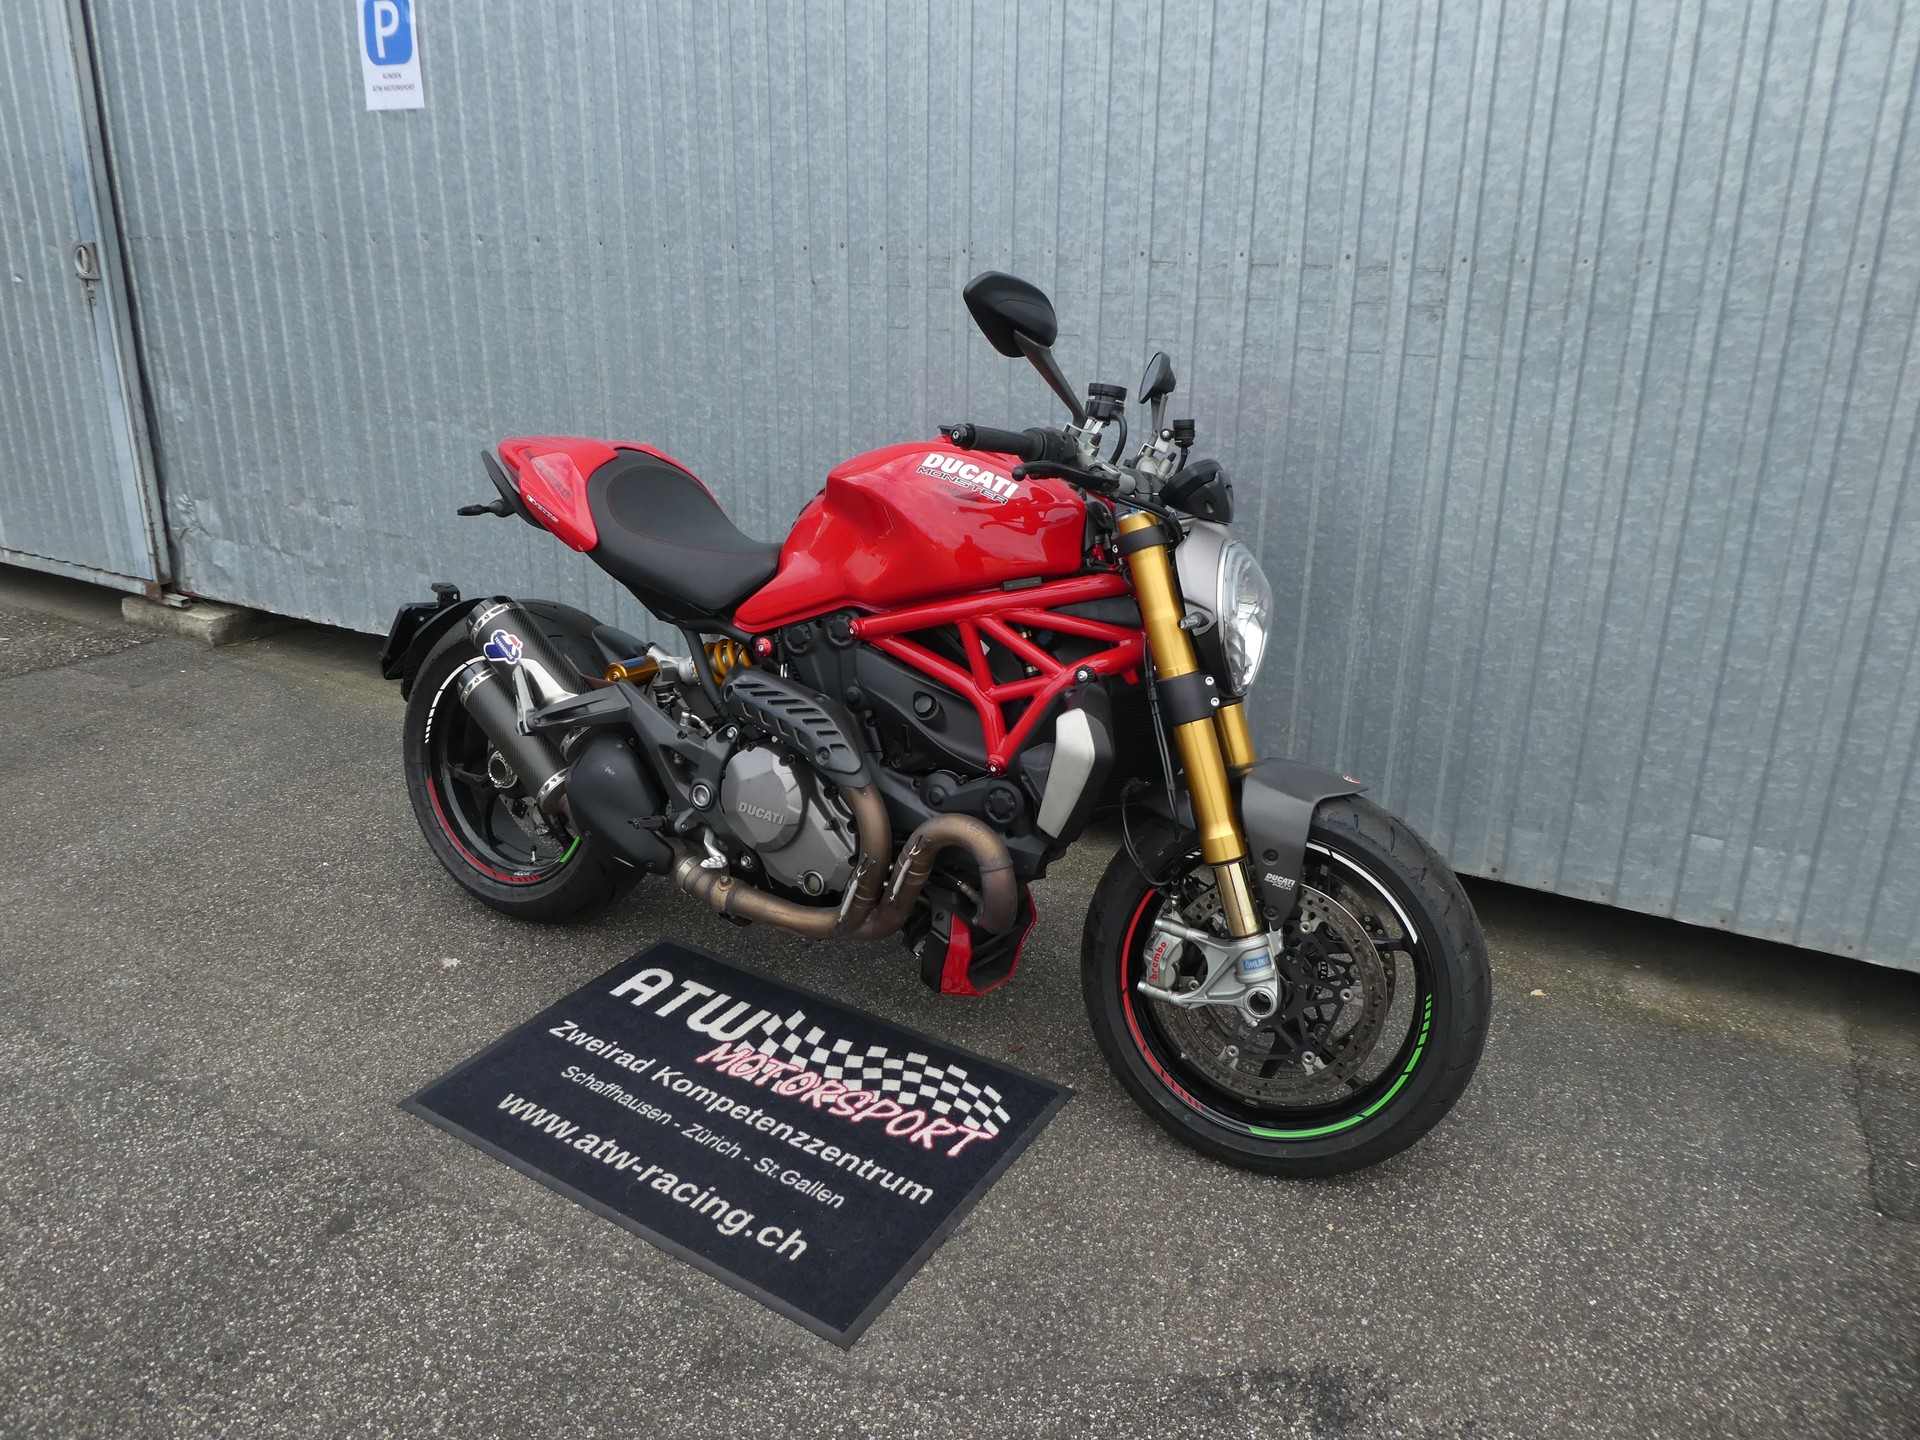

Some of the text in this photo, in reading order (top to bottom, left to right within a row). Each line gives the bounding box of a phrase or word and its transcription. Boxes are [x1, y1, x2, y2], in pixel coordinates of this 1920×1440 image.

[373, 1, 399, 58] P
[916, 466, 1009, 505] MONSTER
[922, 453, 1019, 498] DUCATI
[738, 801, 784, 825] DUCATI
[1265, 872, 1295, 886] DUCATI
[1149, 941, 1167, 981] brembo
[609, 967, 772, 1042] ATW
[549, 1020, 934, 1205] Zweirad Kompetenzzentrum
[694, 1041, 996, 1157] MOTORSPORT
[561, 1065, 672, 1126] Schaffhausen
[681, 1122, 742, 1159] Zürich
[753, 1156, 845, 1208] St.Gallen
[498, 1092, 808, 1261] www.atw-racing.ch
